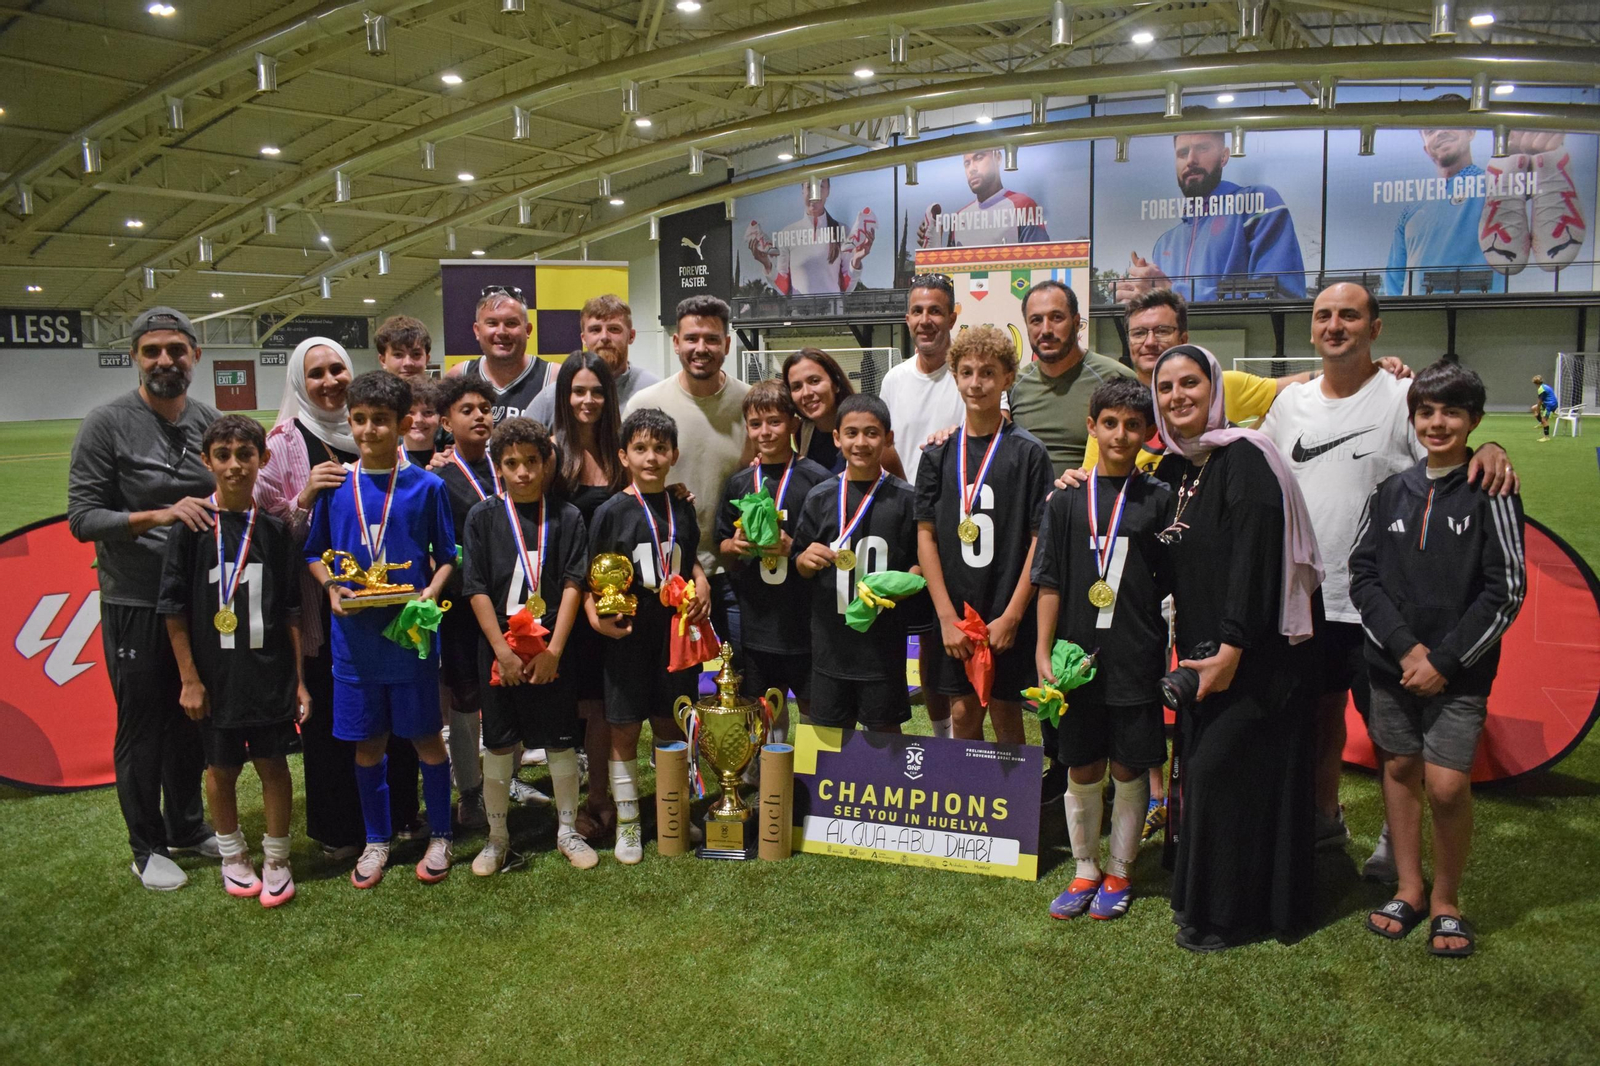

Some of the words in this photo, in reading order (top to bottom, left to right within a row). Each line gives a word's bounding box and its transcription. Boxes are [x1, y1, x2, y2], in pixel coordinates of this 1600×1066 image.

[1373, 171, 1543, 204] FOREVER.GREALISH.
[935, 206, 1048, 232] FOREVER.NEYMAR.
[1140, 192, 1269, 220] FOREVER.GIROUD.
[678, 265, 709, 277] FOREVER.
[681, 277, 707, 288] FASTER.
[11, 315, 78, 343] LESS.
[101, 358, 120, 366] EXIT
[218, 375, 233, 385] EXIT
[959, 483, 994, 568] 6
[1090, 536, 1129, 629] 7
[209, 562, 263, 649] 11
[818, 779, 1009, 820] CHAMPIONS
[662, 791, 679, 839] loch
[763, 794, 780, 843] loch
[833, 805, 862, 818] SEE
[868, 808, 898, 823] YOU
[905, 813, 920, 825] IN
[927, 816, 988, 833] HUELVA
